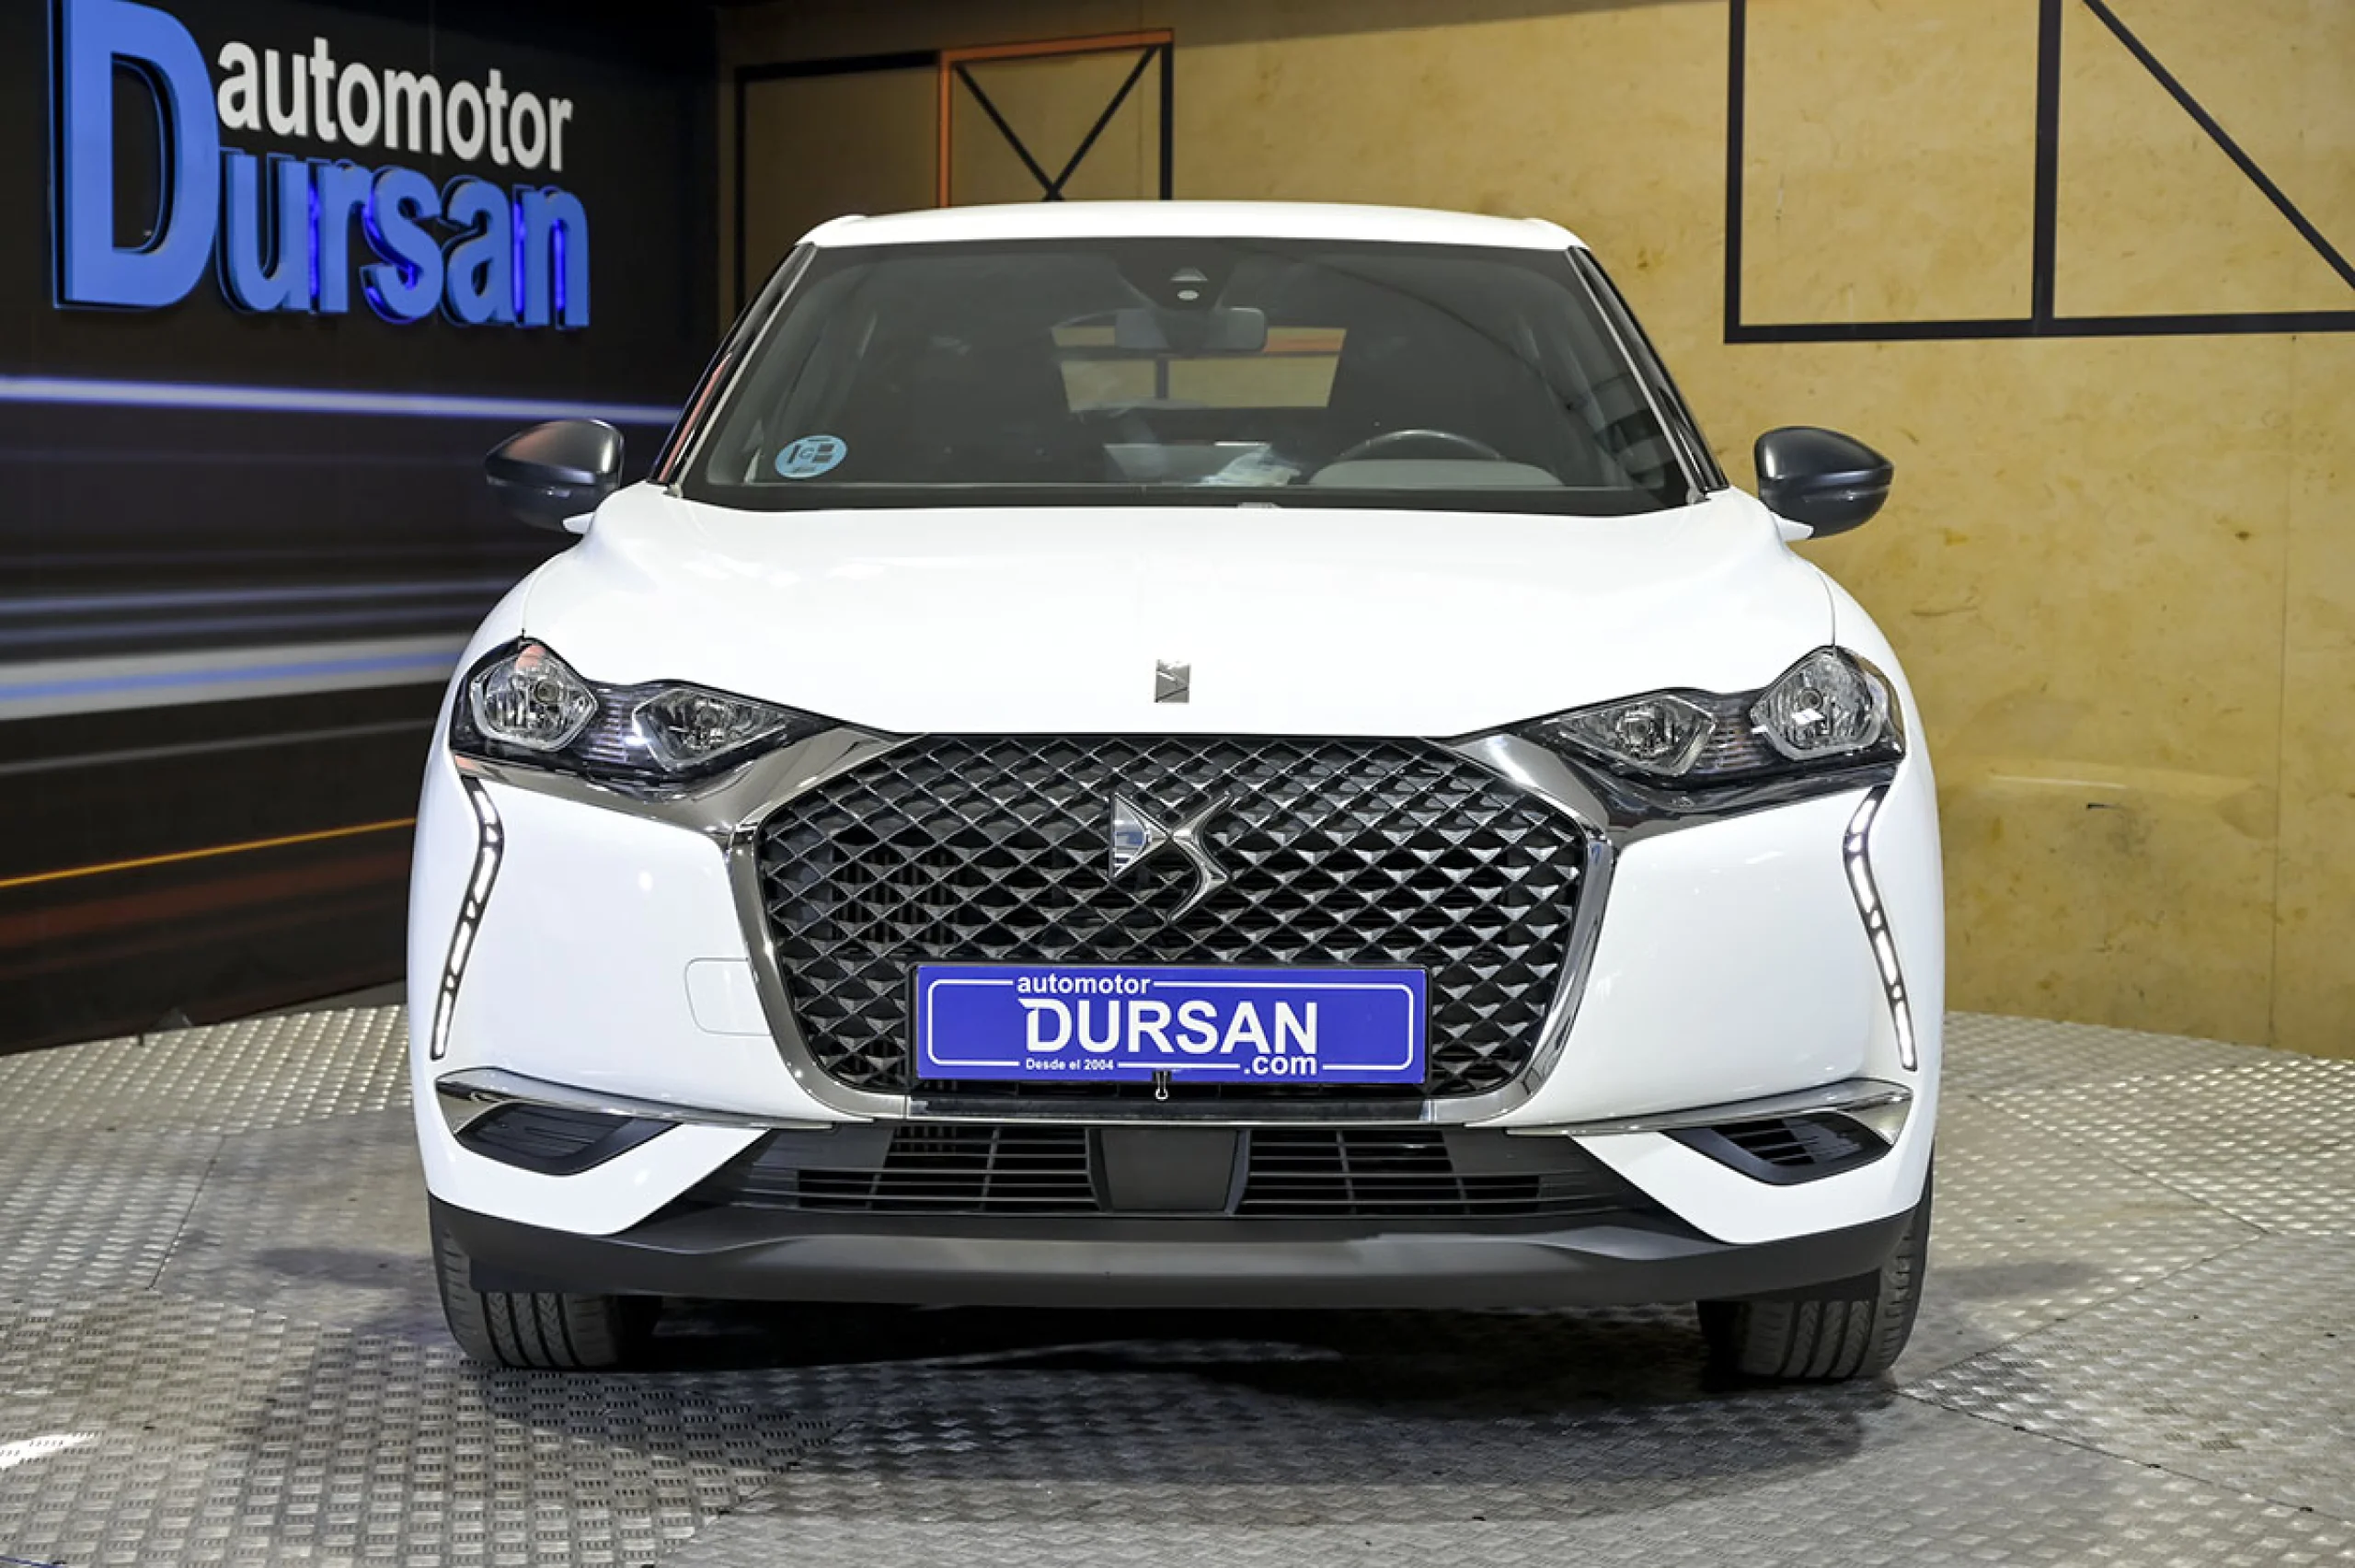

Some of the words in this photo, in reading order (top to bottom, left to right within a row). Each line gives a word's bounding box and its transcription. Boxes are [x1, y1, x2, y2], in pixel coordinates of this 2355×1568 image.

[217, 37, 574, 172] automotor
[50, 0, 590, 329] Dursan
[1017, 973, 1151, 994] automotor
[1018, 998, 1318, 1055] DURSAN
[1026, 1059, 1066, 1070] Desde
[1069, 1059, 1081, 1070] el
[1085, 1059, 1114, 1070] 2004
[1244, 1056, 1318, 1076] .com
